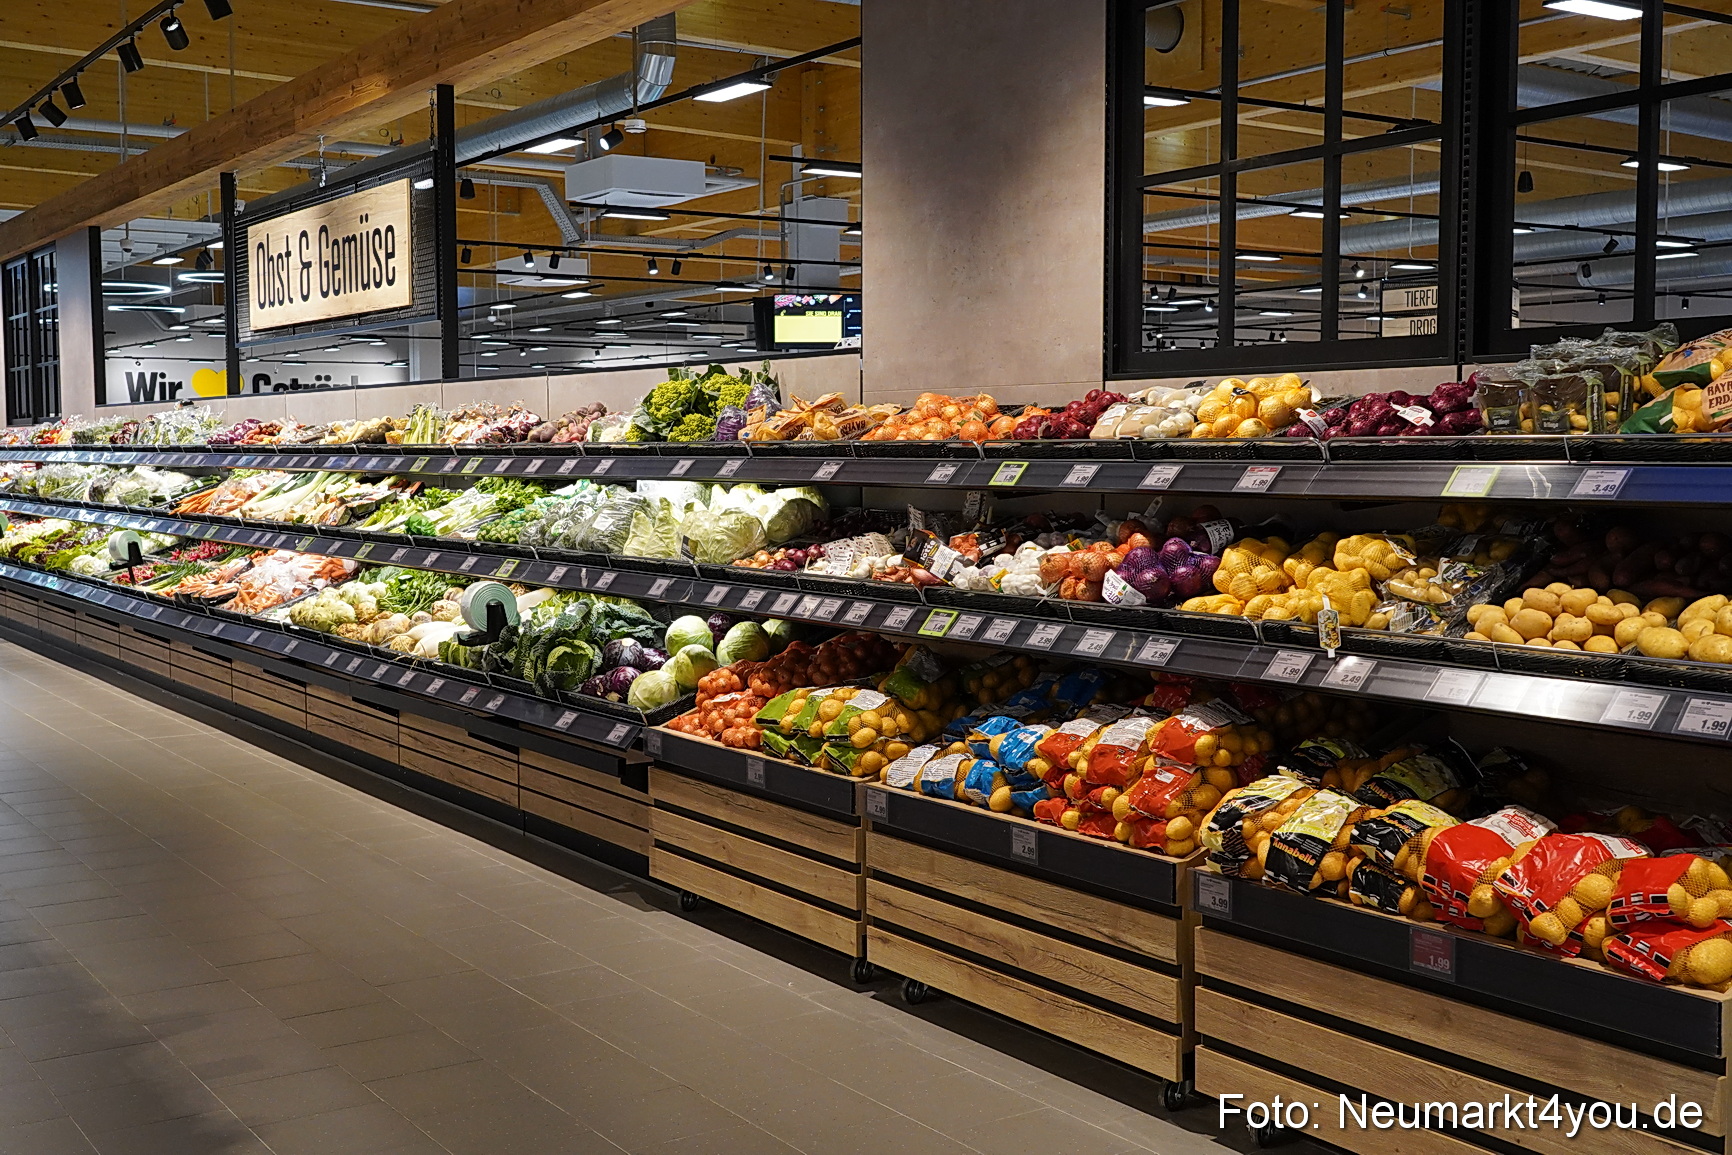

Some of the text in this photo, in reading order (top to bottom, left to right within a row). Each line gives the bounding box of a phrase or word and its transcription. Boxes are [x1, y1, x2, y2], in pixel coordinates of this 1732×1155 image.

[256, 212, 396, 310] Obst & Gemüse
[1404, 288, 1438, 308] TIERFU
[1409, 318, 1436, 336] DROG
[124, 370, 184, 403] Wir
[1074, 475, 1090, 483] 1.99
[1154, 477, 1171, 485] 2.49
[1251, 479, 1269, 487] 1.99
[1592, 484, 1617, 493] 3.49
[993, 631, 1008, 639] 1.49
[1037, 636, 1053, 645] 2.99
[1087, 642, 1104, 651] 2.49
[1150, 651, 1167, 660] 2.99
[1281, 666, 1301, 676] 1.99
[1341, 674, 1362, 684] 2.49
[1627, 709, 1652, 721] 1.99
[1701, 719, 1727, 731] 1.99
[875, 804, 886, 815] 2.99
[1022, 845, 1035, 857] 2.99
[1272, 837, 1317, 867] Annabelle
[1211, 896, 1228, 909] 3.99
[1429, 954, 1450, 970] 1.99
